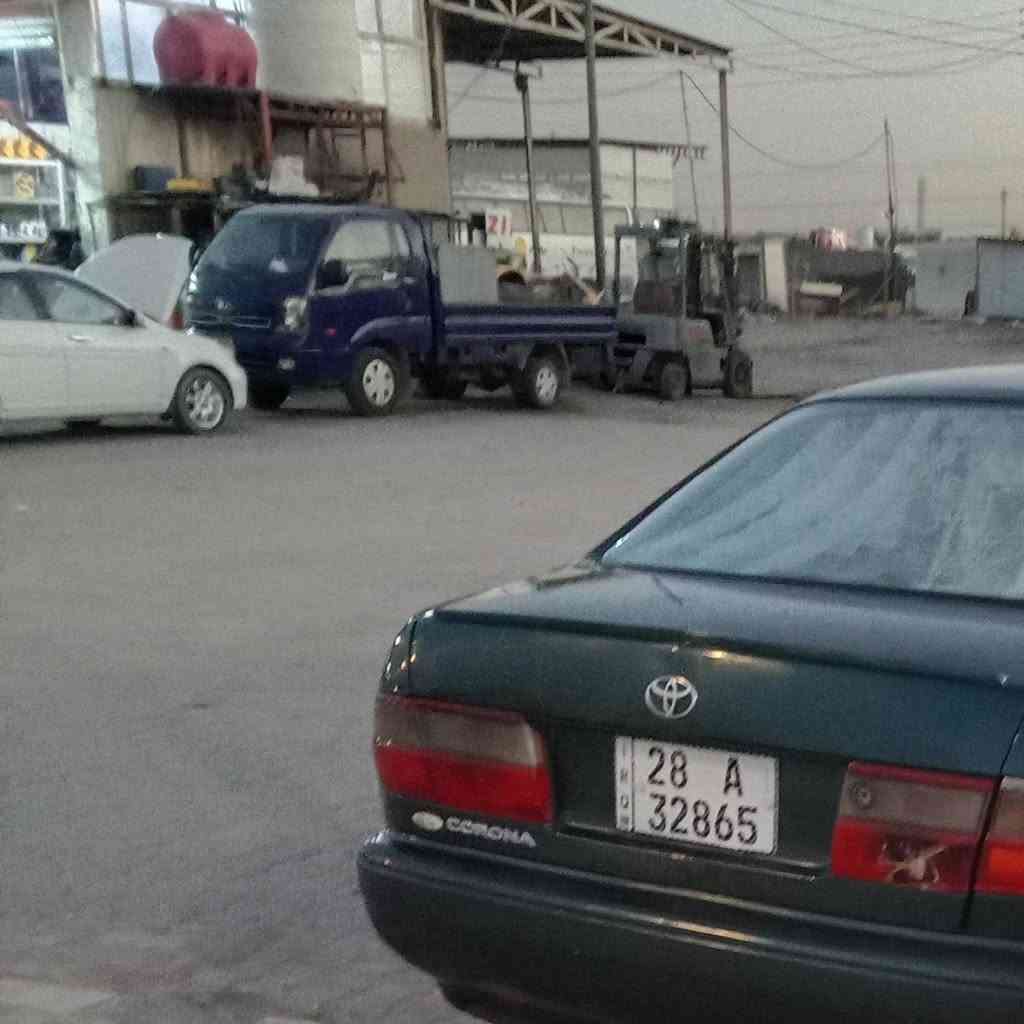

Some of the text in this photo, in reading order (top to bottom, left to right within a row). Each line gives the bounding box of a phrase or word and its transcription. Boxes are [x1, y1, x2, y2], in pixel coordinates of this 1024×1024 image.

[648, 747, 743, 797] 28 A
[445, 815, 537, 848] CORONA
[648, 793, 757, 845] 32865
